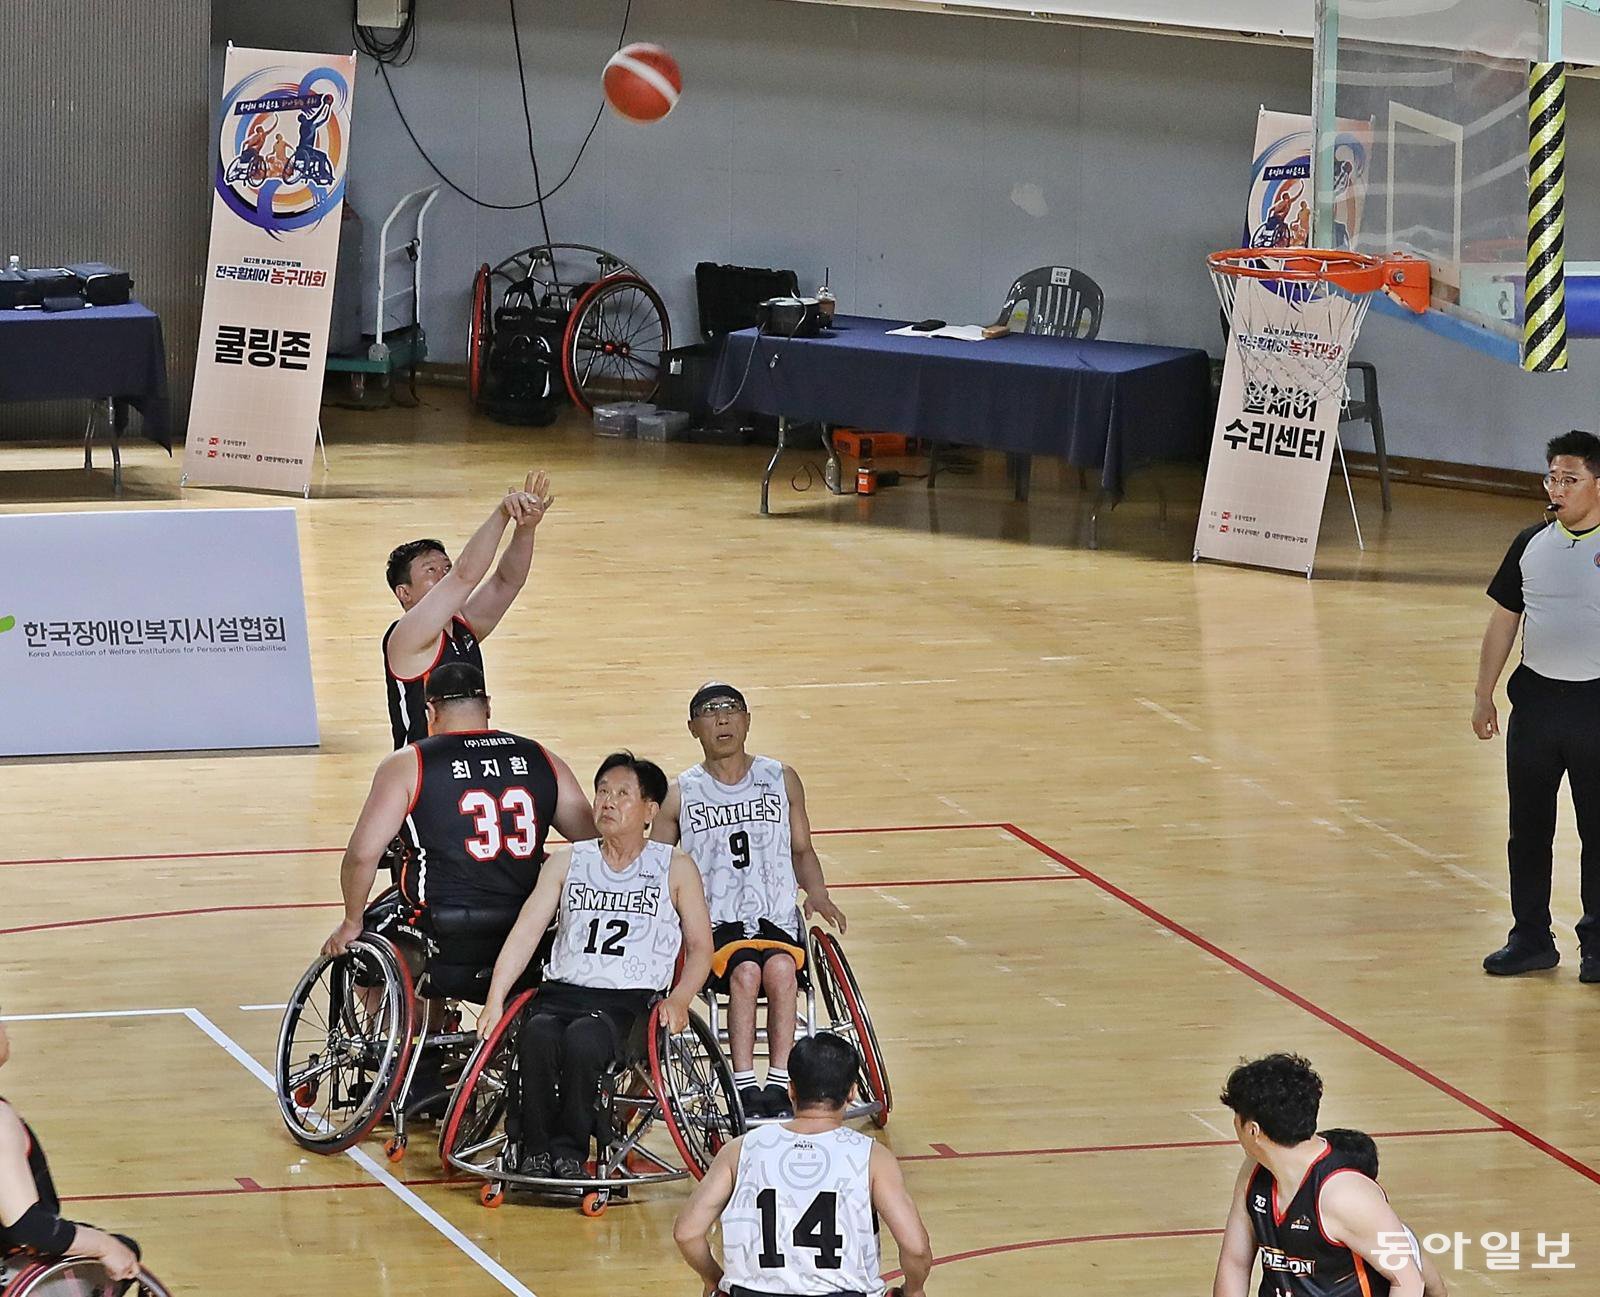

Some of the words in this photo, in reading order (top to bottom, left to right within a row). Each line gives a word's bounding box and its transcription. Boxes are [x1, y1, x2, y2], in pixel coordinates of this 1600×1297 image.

[215, 265, 270, 282] 전국휠체어
[270, 268, 327, 287] 농구대회
[215, 325, 311, 371] 쿨링존
[1223, 418, 1325, 462] 수리센터
[24, 616, 286, 648] 한국장애인복지시설협회
[52, 649, 96, 657] Association
[98, 648, 106, 656] of
[138, 647, 181, 655] Institutions
[246, 644, 287, 652] Disabilities
[458, 786, 538, 862] 33
[688, 793, 781, 834] SMILES
[729, 830, 751, 870] 9
[569, 883, 661, 917] SMILES
[583, 918, 630, 957] 12
[756, 1188, 843, 1269] 14
